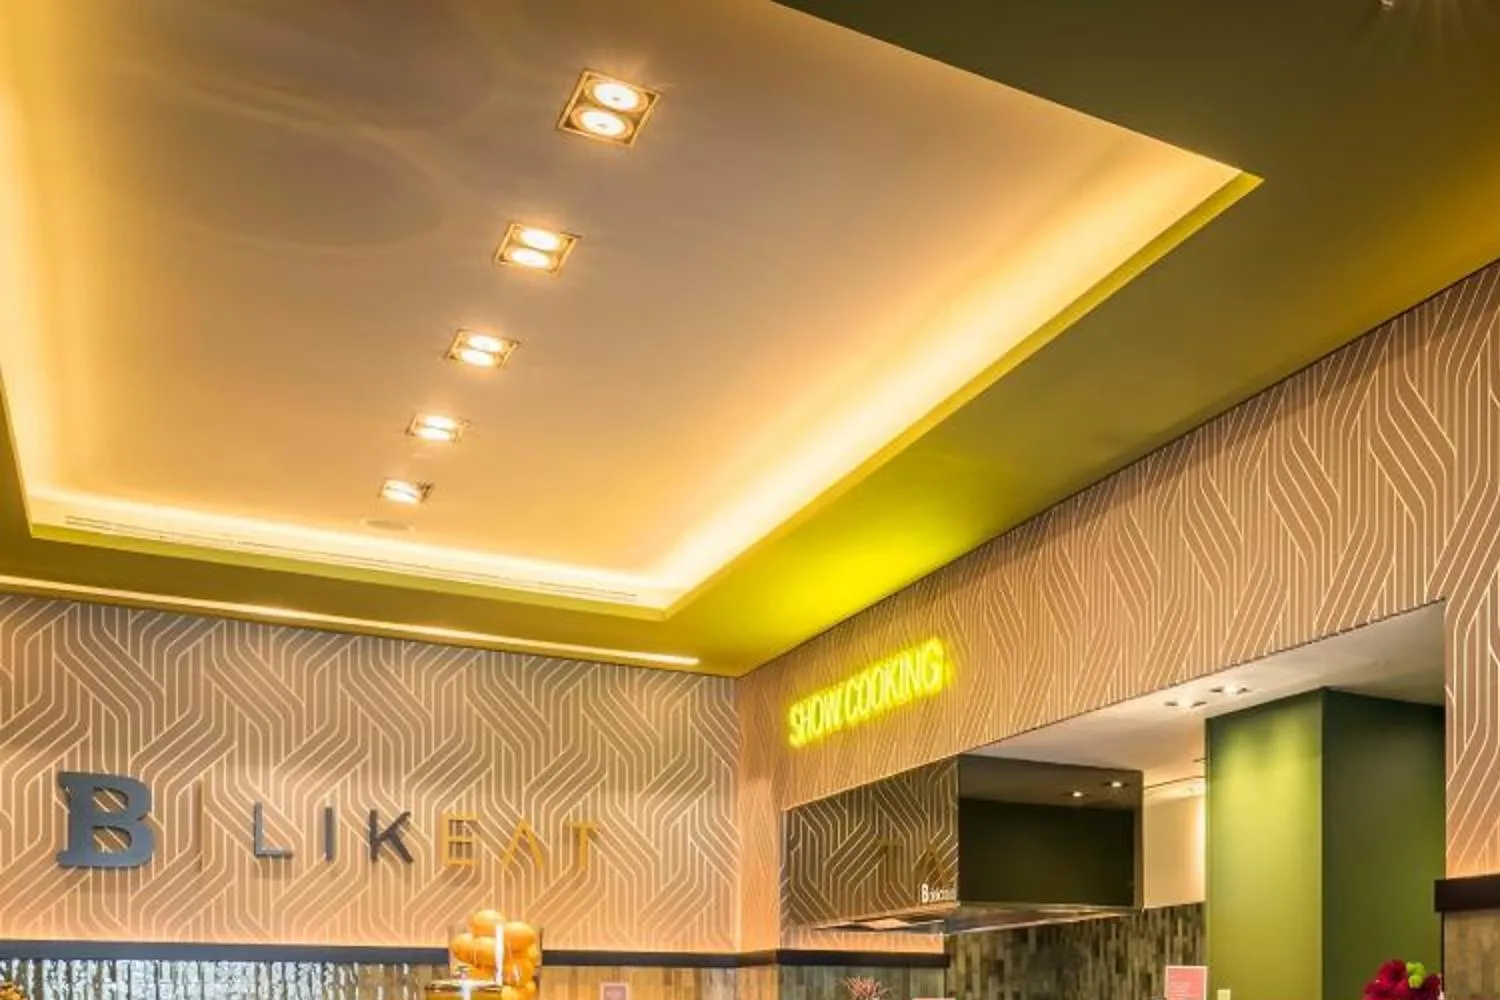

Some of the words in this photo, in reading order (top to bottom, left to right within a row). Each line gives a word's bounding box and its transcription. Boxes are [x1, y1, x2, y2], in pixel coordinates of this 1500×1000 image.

[788, 683, 844, 747] SHOW
[845, 637, 944, 722] COOKING
[55, 770, 156, 869] B
